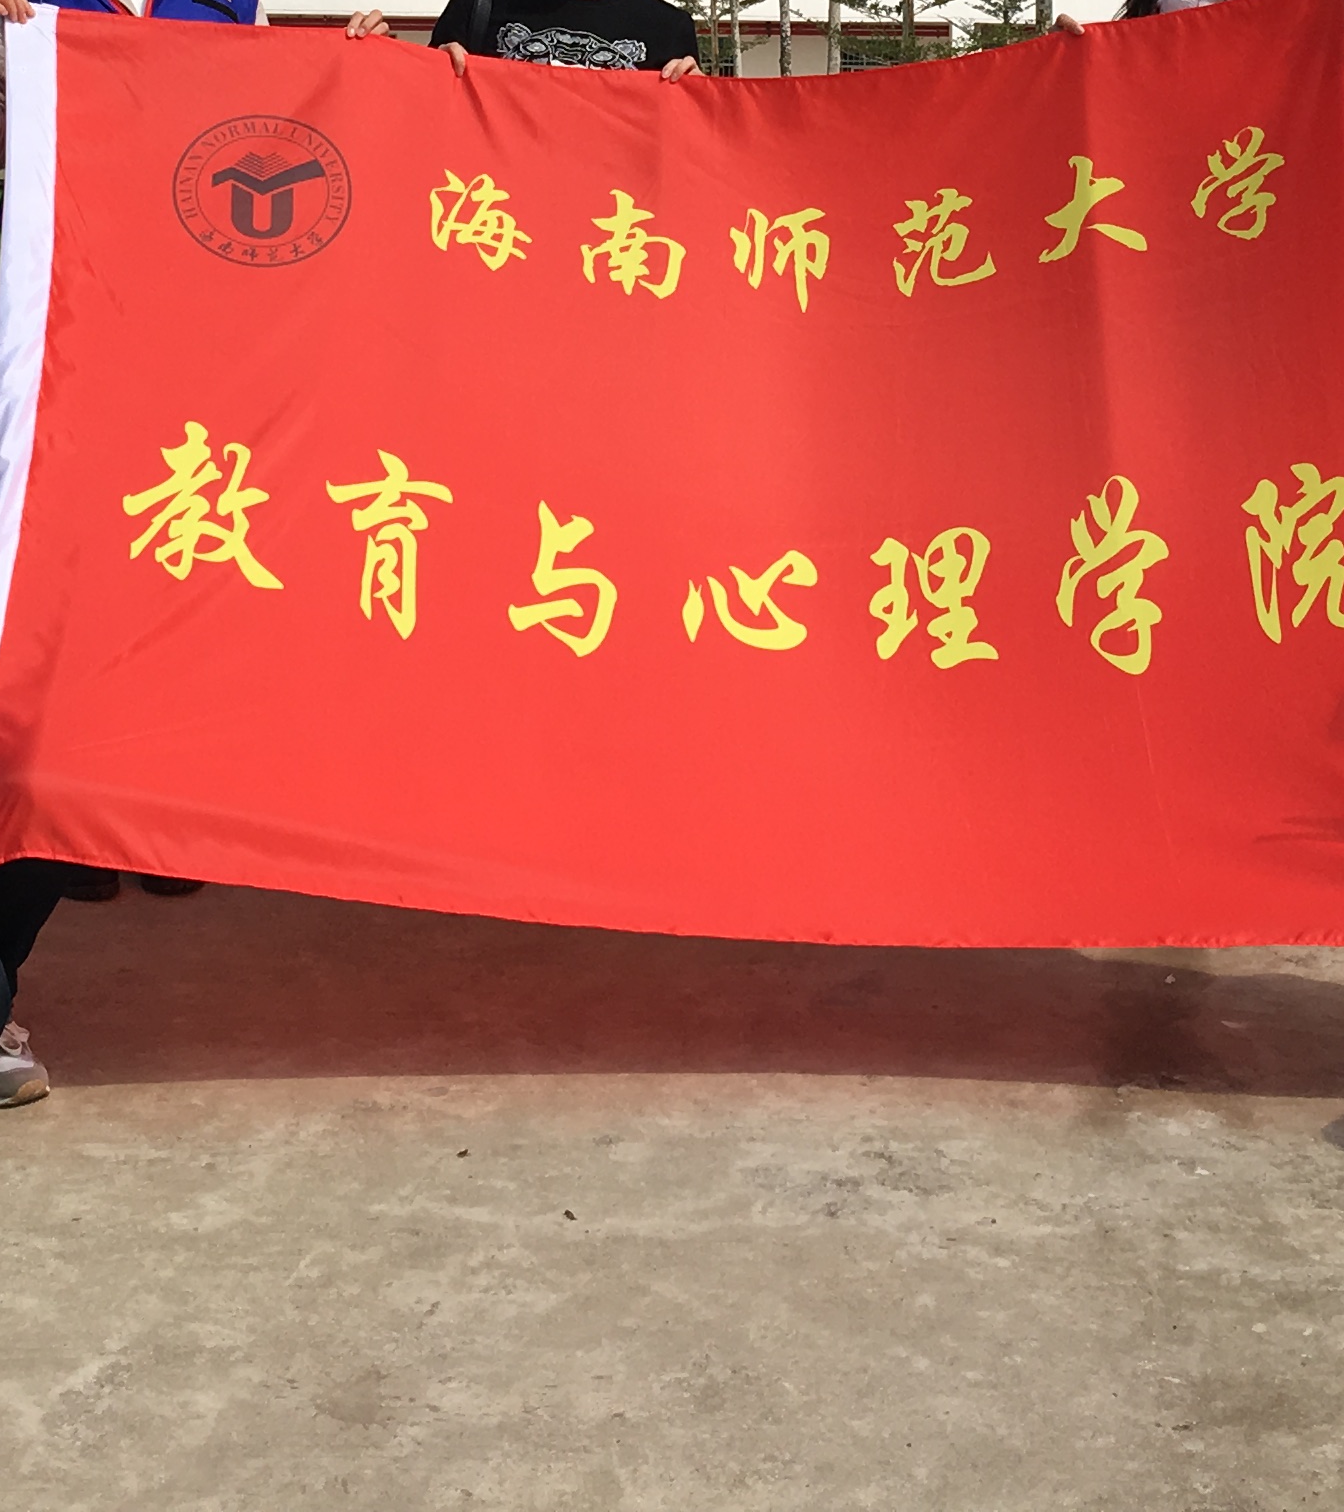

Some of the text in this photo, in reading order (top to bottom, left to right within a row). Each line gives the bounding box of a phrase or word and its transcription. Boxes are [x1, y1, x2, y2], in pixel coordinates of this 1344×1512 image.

[178, 120, 346, 224] HAINAN NORMAL UNIVERSITY
[429, 125, 1285, 312] 海南师范大学
